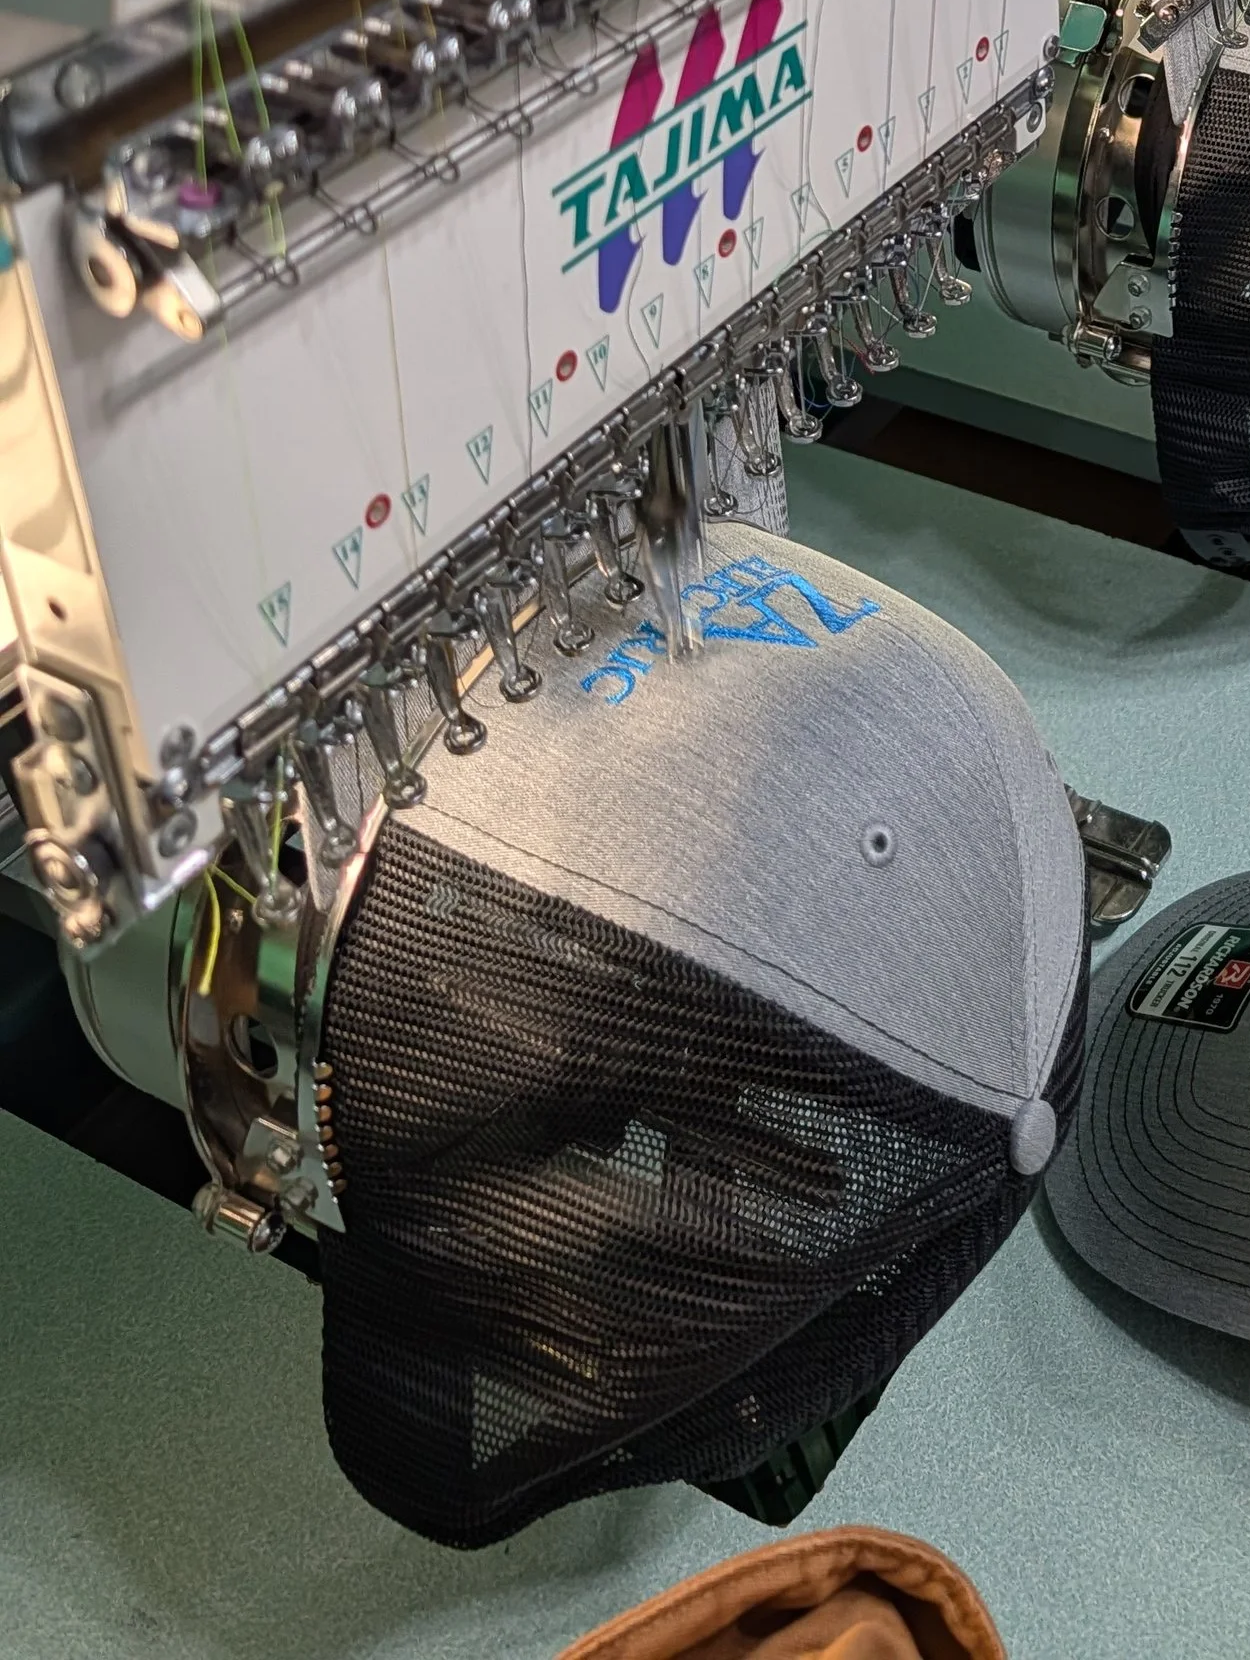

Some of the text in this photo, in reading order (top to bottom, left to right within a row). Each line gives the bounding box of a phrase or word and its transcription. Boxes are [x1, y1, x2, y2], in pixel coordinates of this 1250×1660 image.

[559, 43, 806, 249] TAJIMA
[580, 554, 790, 707] ELECRIC
[1166, 956, 1198, 978] 112
[1176, 935, 1241, 1010] RICHARDSON
[1205, 993, 1224, 1016] 1970
